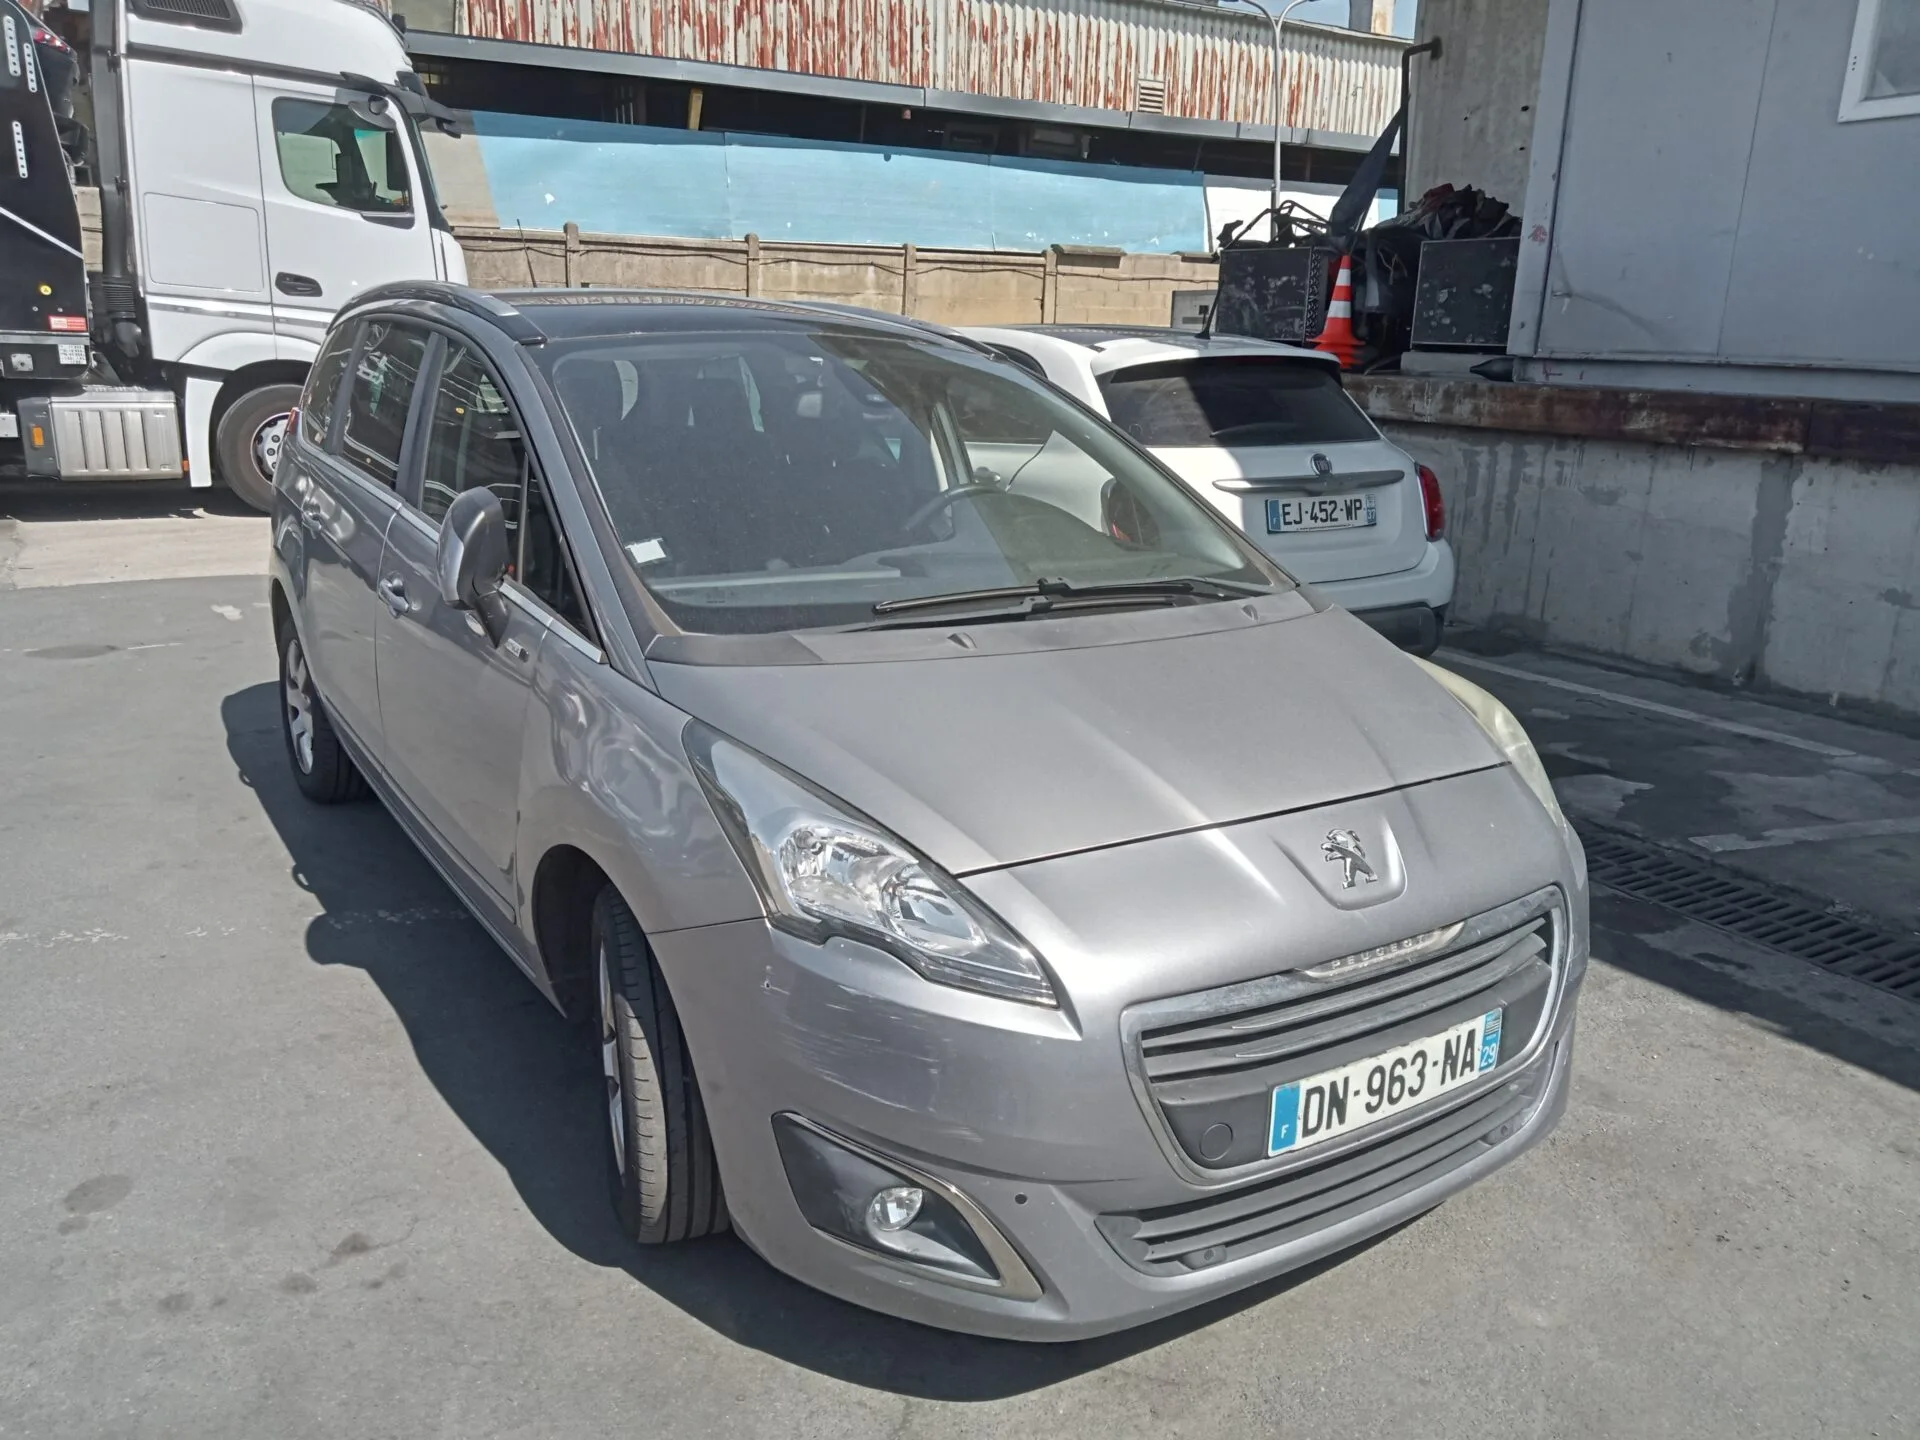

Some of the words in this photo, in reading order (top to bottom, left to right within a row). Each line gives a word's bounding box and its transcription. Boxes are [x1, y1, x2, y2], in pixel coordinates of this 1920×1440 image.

[1331, 934, 1425, 970] PEUGEOT
[1281, 1124, 1289, 1139] F
[1302, 1028, 1477, 1138] DN-963-NA
[1480, 1043, 1497, 1067] 29
